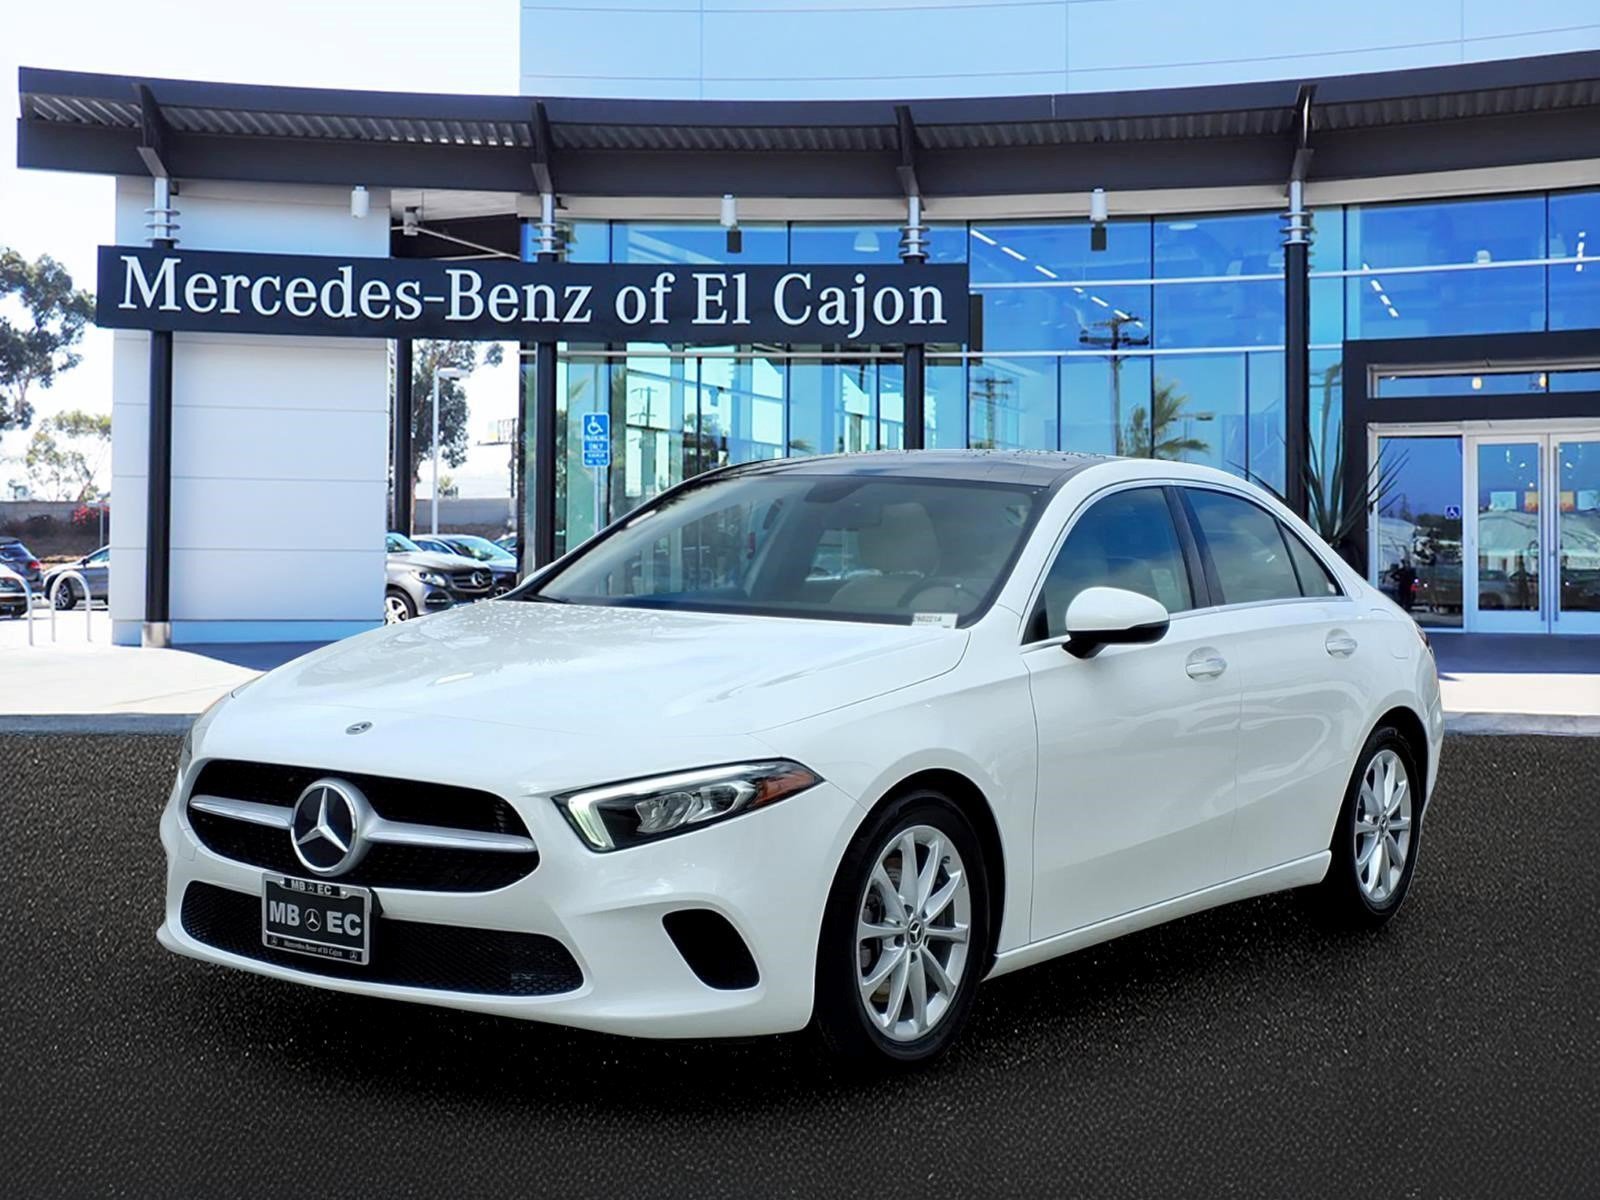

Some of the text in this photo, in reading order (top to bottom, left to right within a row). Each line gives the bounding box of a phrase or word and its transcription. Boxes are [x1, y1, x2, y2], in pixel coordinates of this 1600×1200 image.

[118, 255, 947, 339] Mercedes-Benz of El Cajon
[291, 880, 332, 895] MB EC
[269, 900, 362, 936] MB EC
